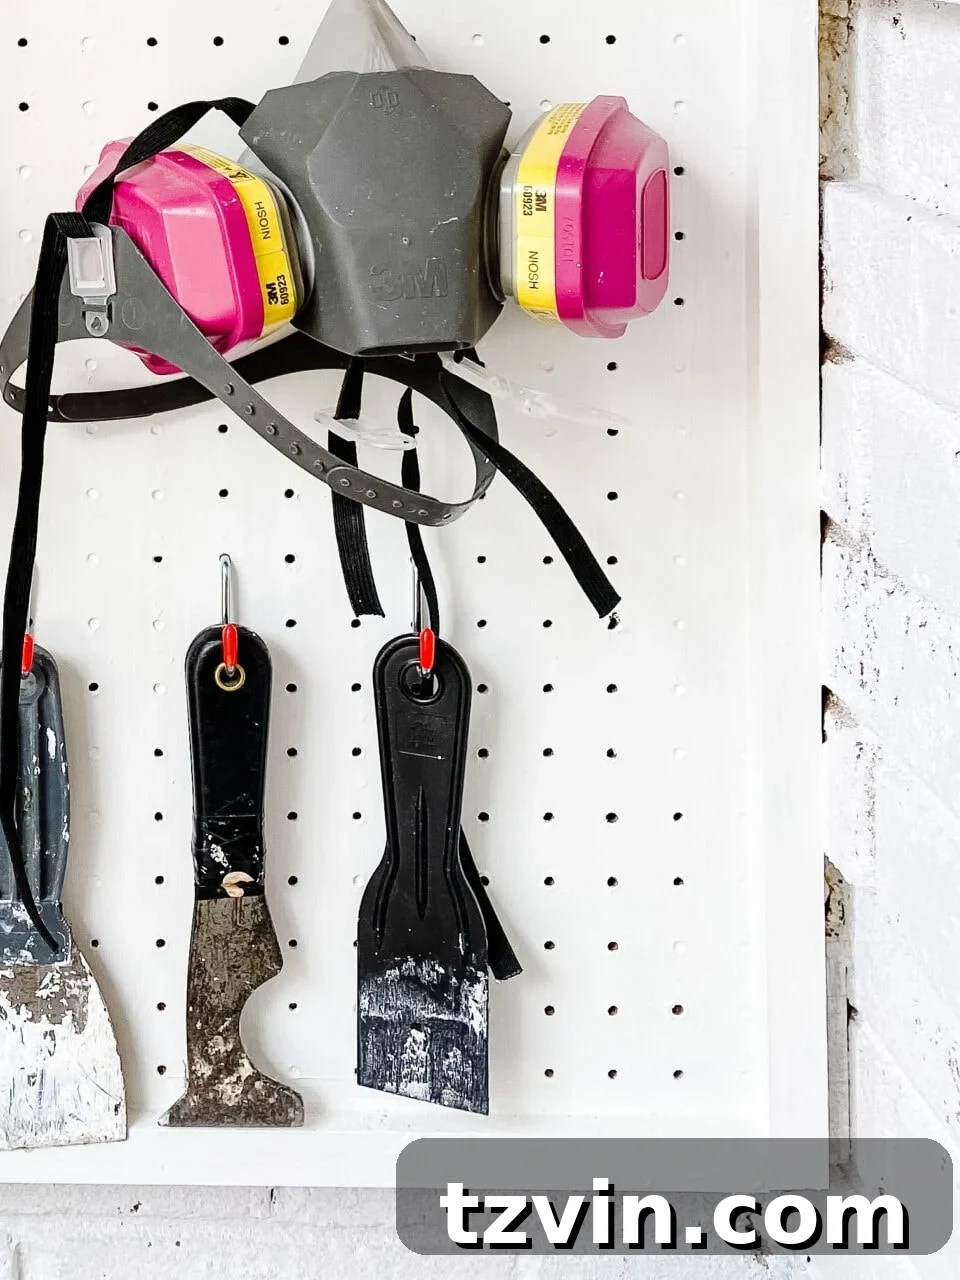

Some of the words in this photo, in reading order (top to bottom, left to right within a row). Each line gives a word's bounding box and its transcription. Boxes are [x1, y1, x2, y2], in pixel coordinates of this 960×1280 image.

[522, 185, 533, 217] 60923
[534, 189, 548, 212] 3M
[254, 201, 272, 240] NIOSH
[367, 256, 449, 302] 3M
[528, 250, 539, 290] NIOSH
[266, 282, 279, 306] 3M
[276, 274, 290, 306] 60923
